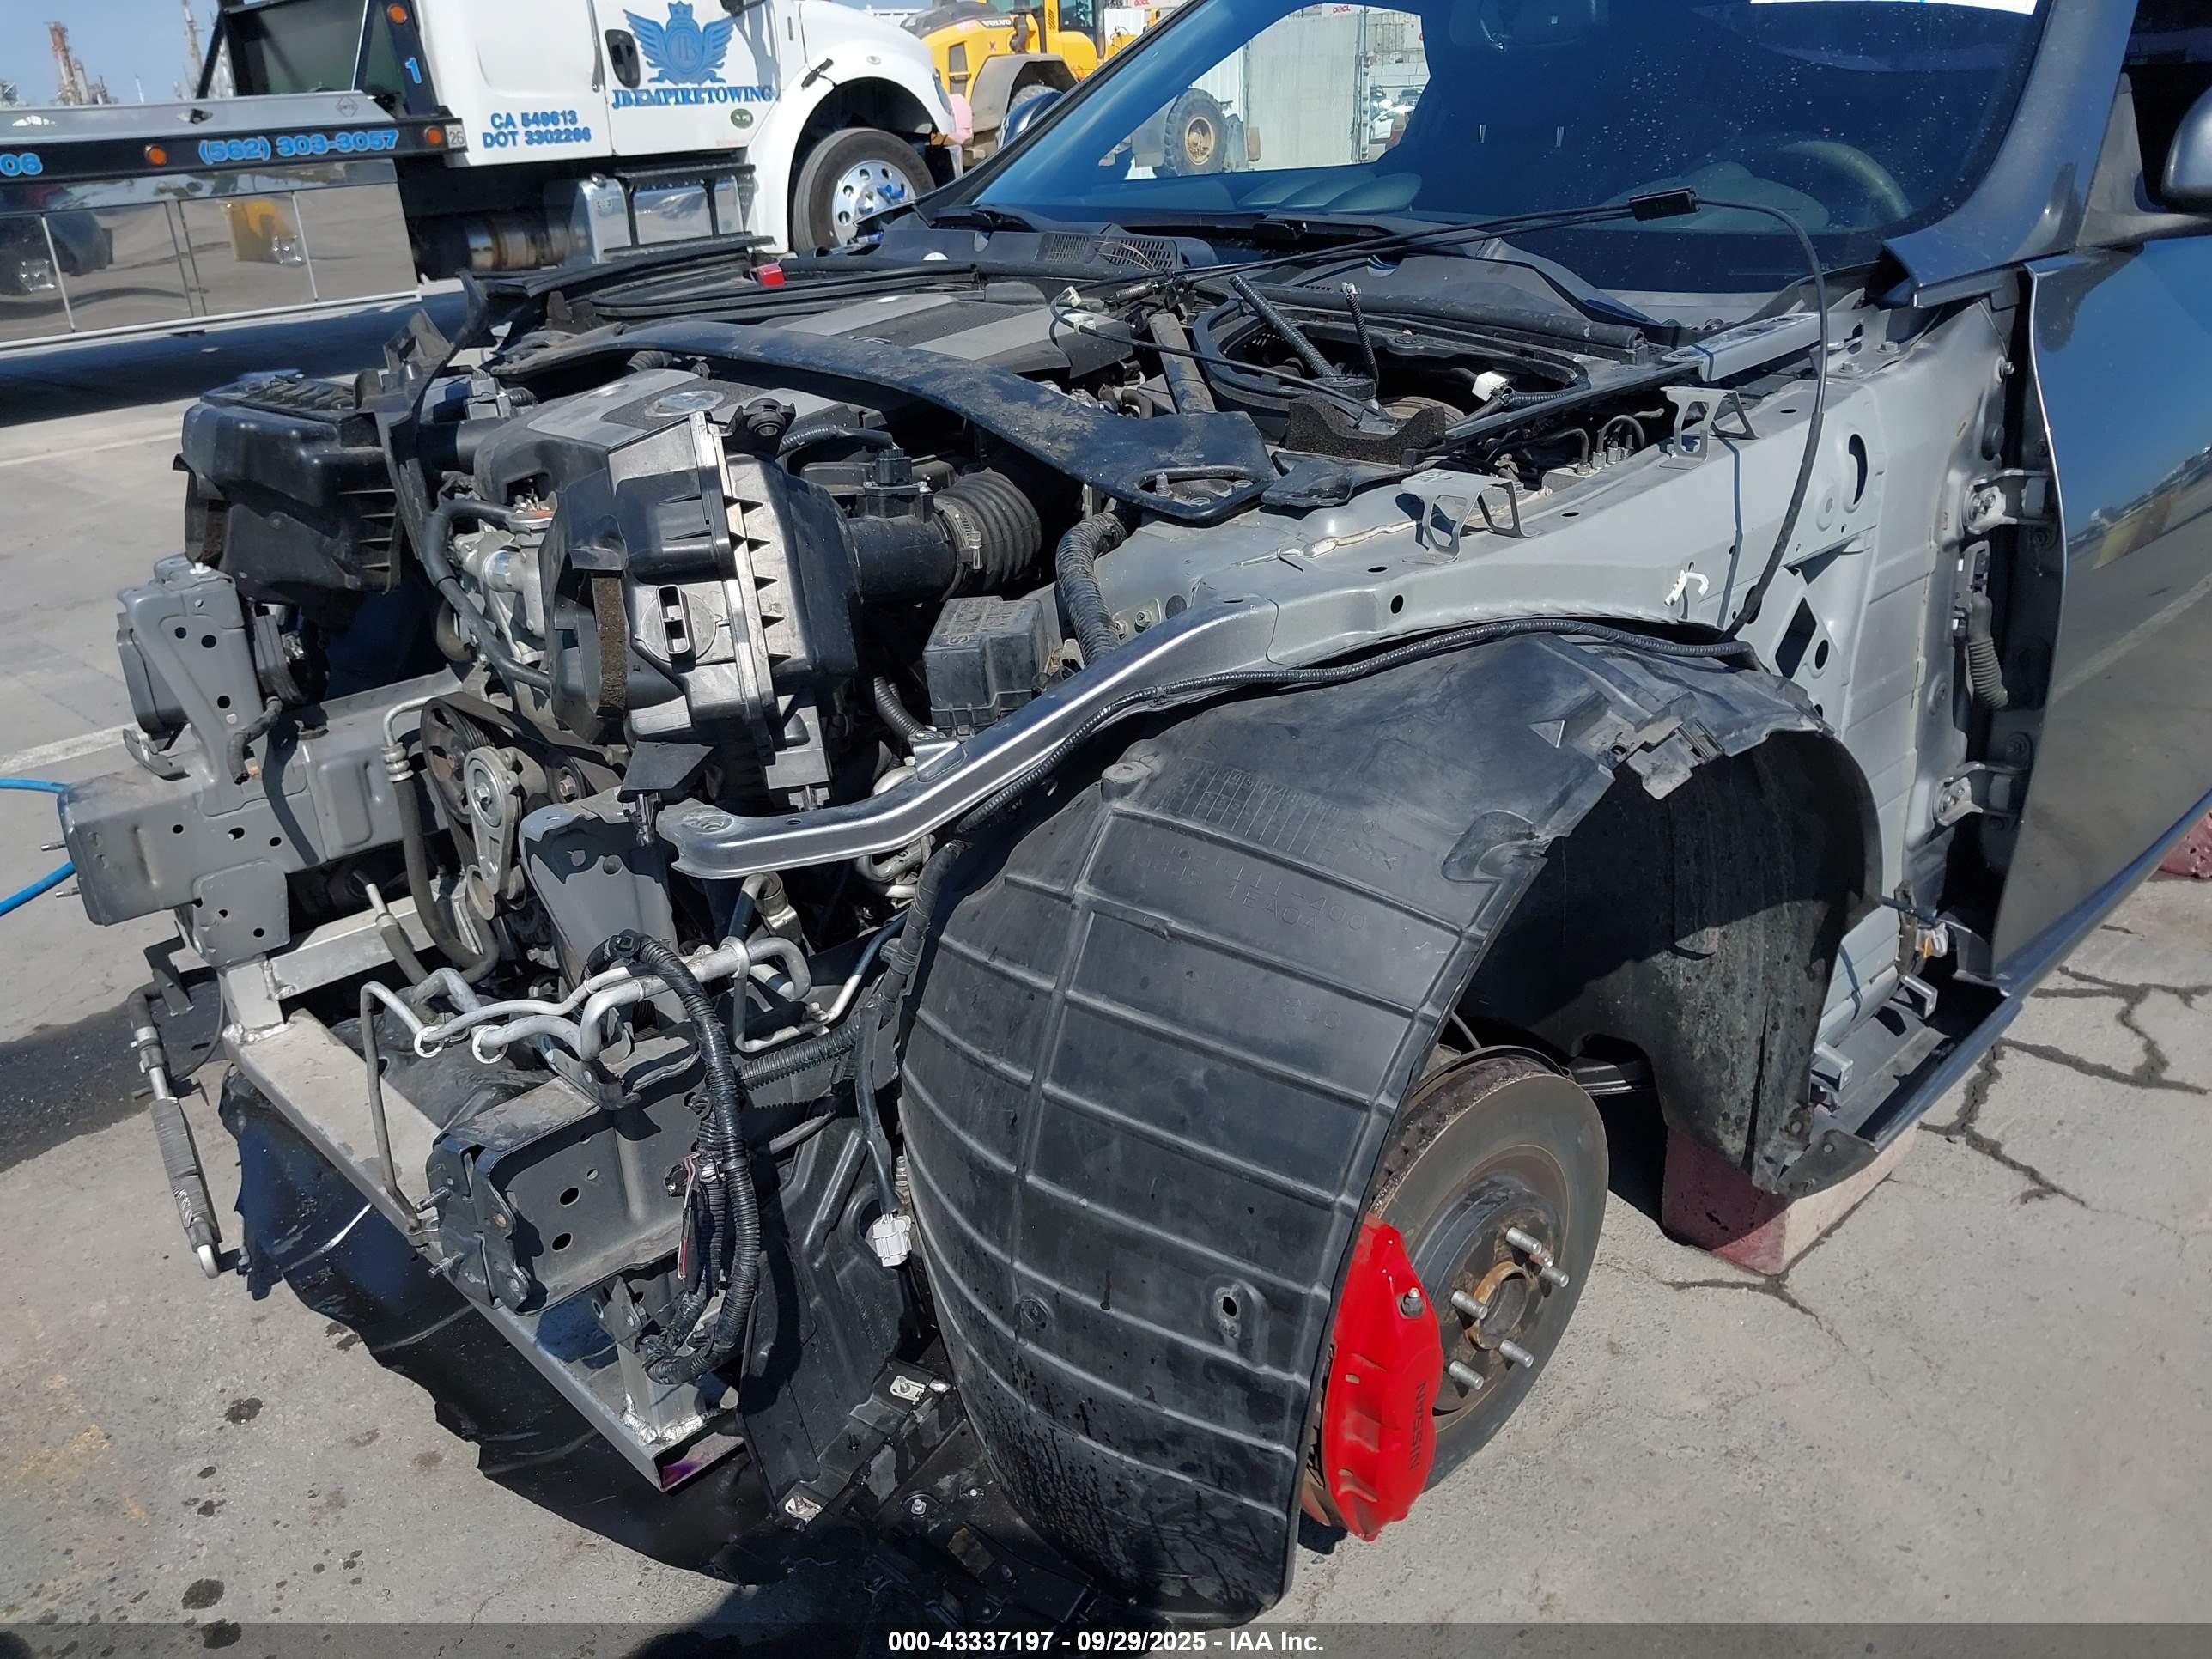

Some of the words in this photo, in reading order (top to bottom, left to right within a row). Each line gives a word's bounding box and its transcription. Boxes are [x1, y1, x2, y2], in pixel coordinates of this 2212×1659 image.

[404, 57, 422, 84] 1
[490, 112, 517, 130] CA
[198, 135, 271, 165] (562)
[276, 129, 399, 157] 303-3057
[448, 131, 465, 145] 26
[482, 130, 518, 149] DOT
[1408, 1380, 1427, 1471] NISSAN
